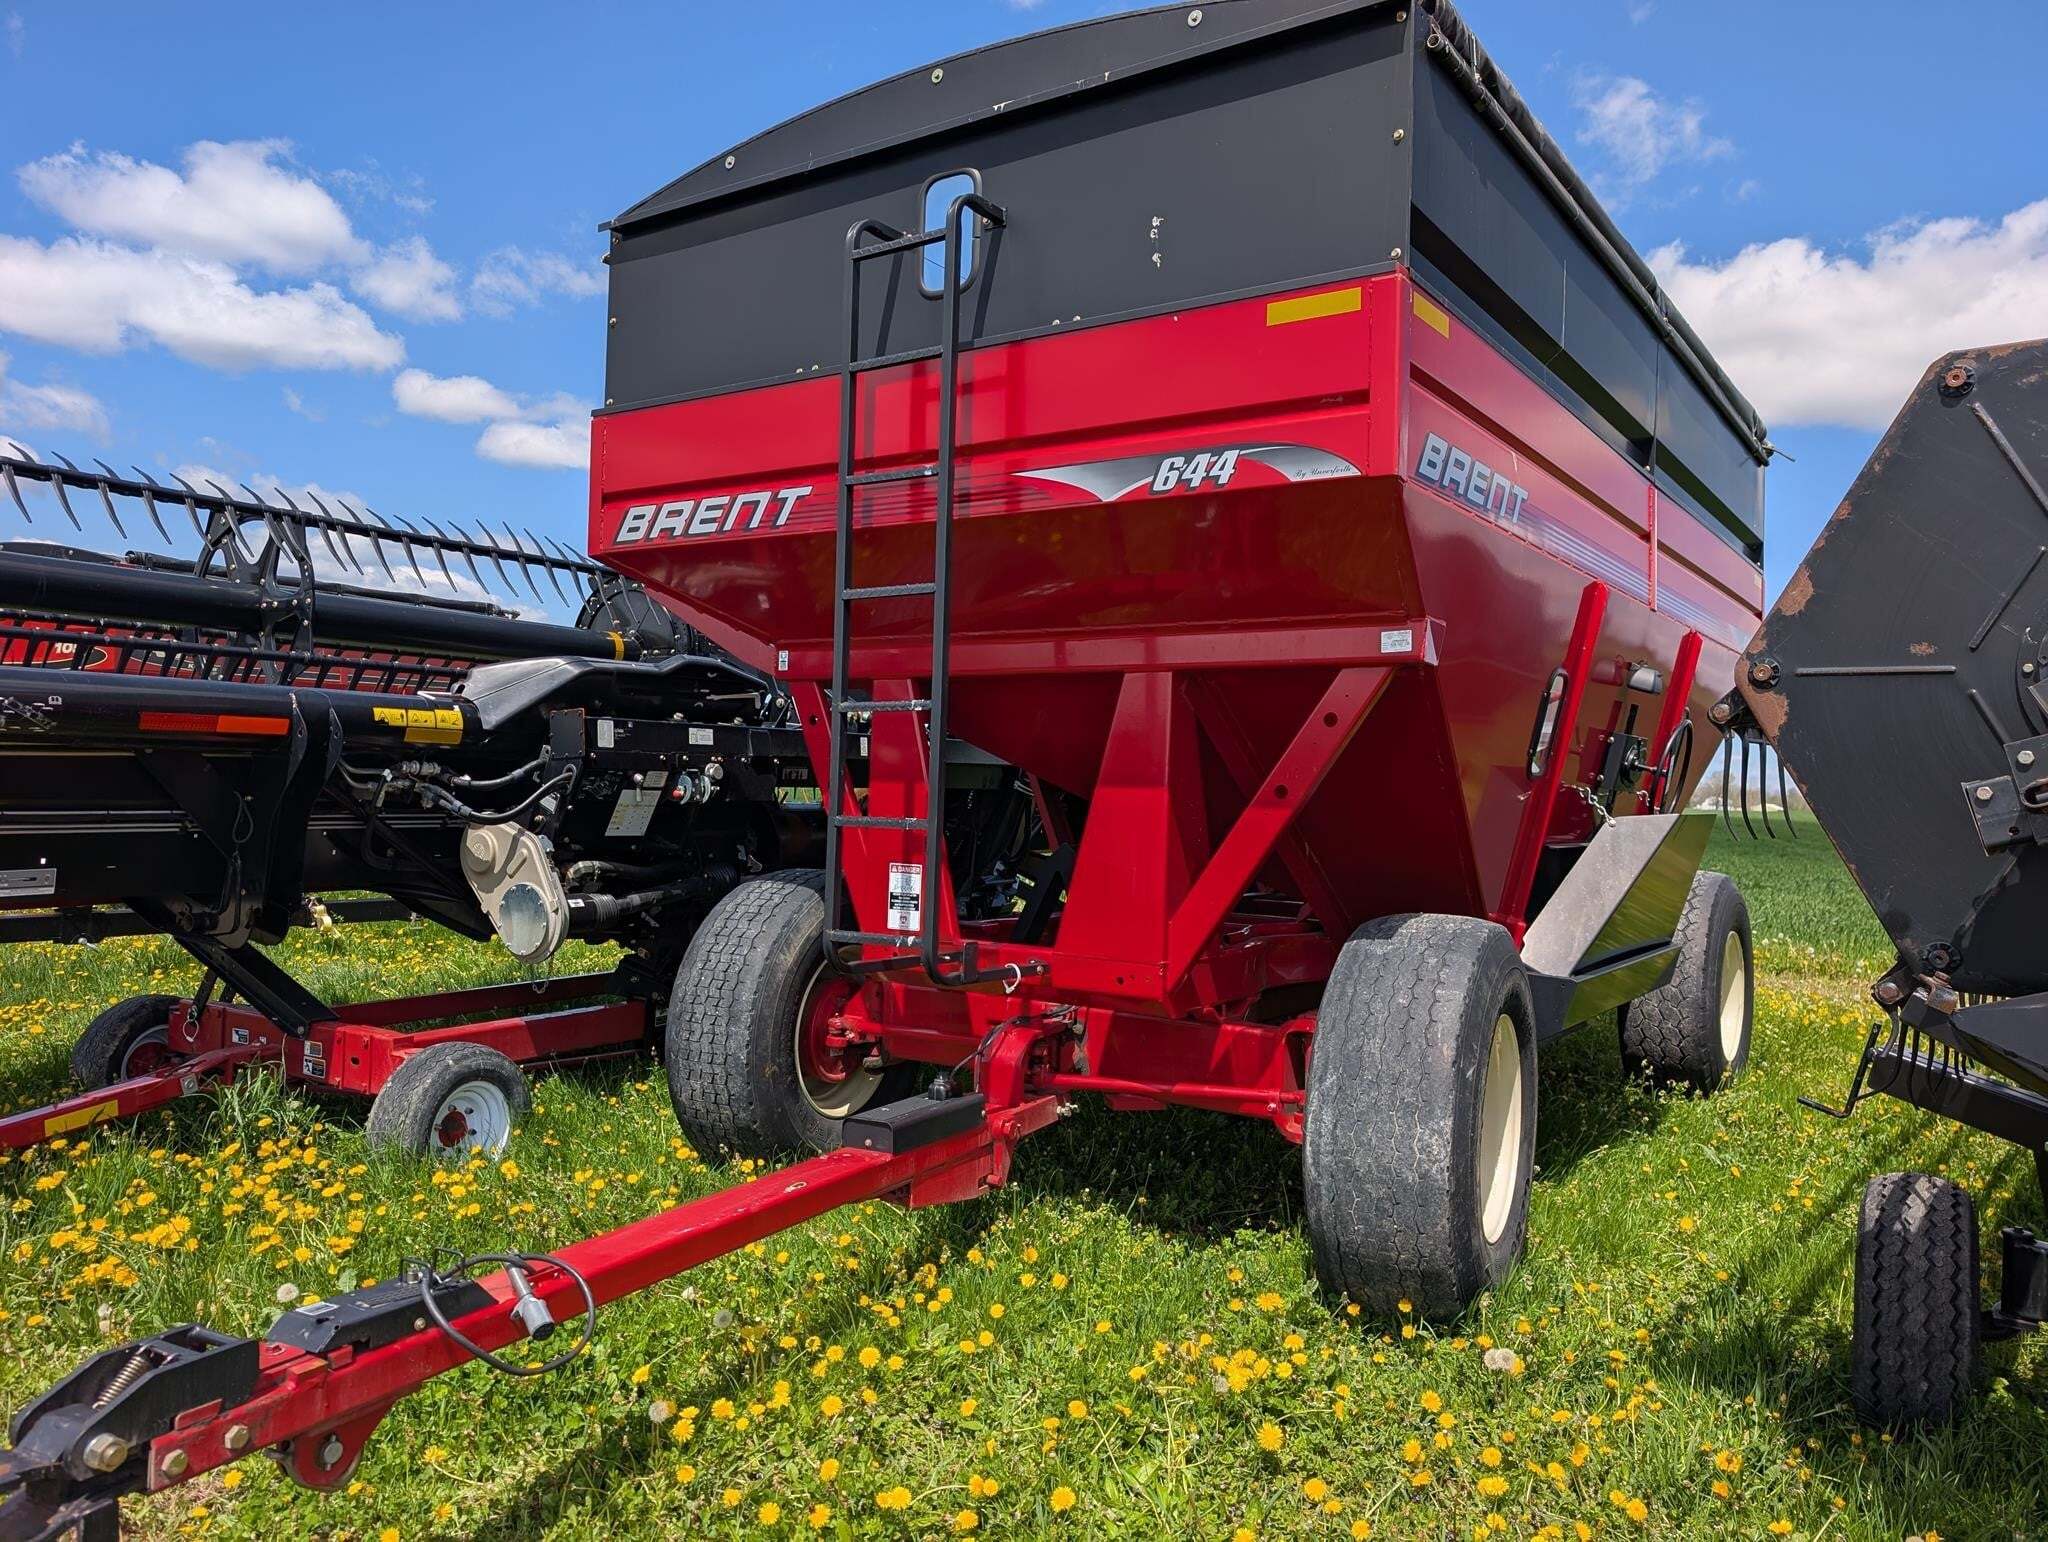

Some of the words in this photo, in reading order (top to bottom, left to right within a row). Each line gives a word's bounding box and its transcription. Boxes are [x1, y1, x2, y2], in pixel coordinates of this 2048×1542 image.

[1151, 449, 1240, 493] 644
[1416, 432, 1529, 523] BRENT
[614, 485, 814, 544] BRENT
